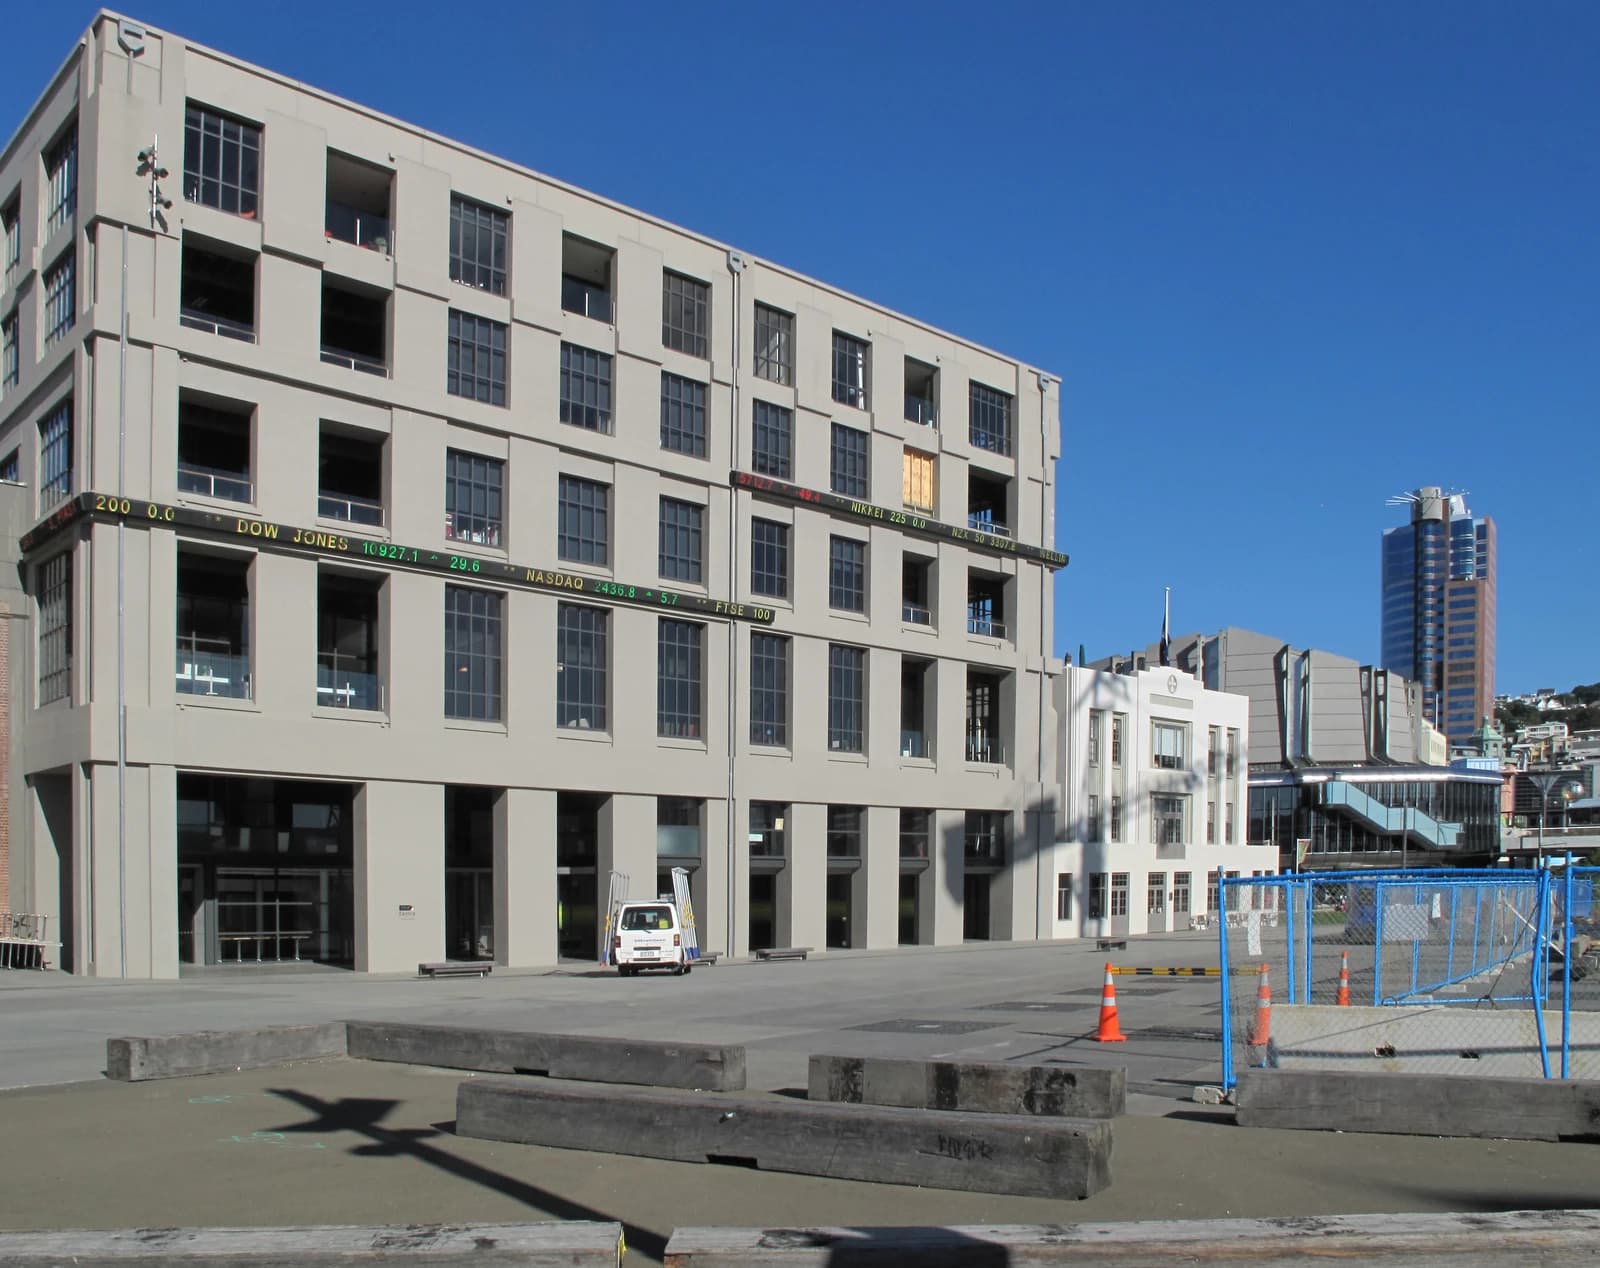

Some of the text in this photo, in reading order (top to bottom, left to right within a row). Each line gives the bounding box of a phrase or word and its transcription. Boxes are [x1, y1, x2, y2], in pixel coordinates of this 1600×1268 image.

[96, 496, 770, 621] 200 0.0 DOW JONES 10927.1 29.6 NASDAQ 2436.8 5.7 FTSE 100
[851, 502, 884, 519] NIKKEI
[890, 511, 906, 524] 225
[912, 517, 926, 529] 0.0
[951, 527, 968, 540] NZX
[975, 532, 985, 543] 50
